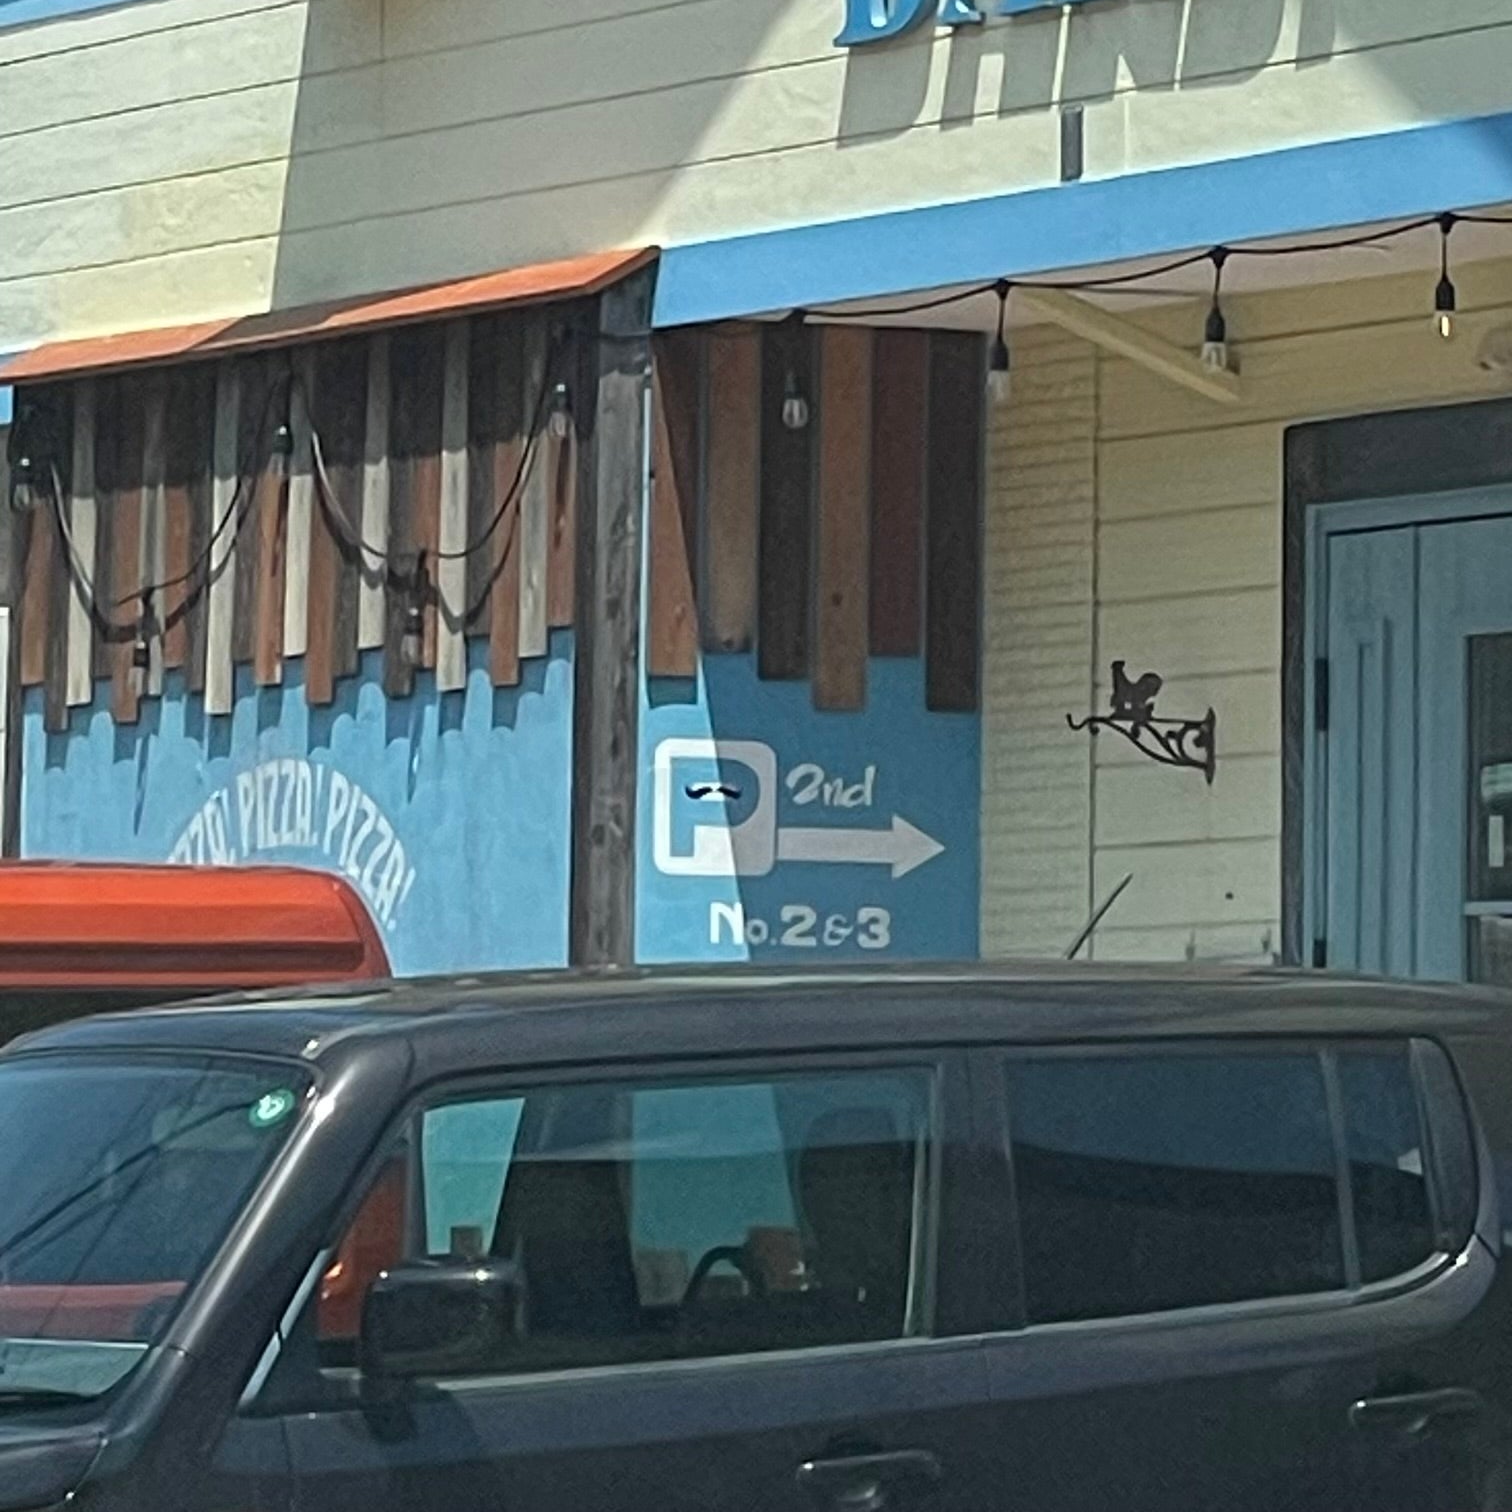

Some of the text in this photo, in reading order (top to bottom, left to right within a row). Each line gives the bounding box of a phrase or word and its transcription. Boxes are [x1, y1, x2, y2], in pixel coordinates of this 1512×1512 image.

[785, 762, 877, 808] 2nd
[236, 758, 325, 857] PIZZA!
[324, 769, 417, 932] PIZZA!
